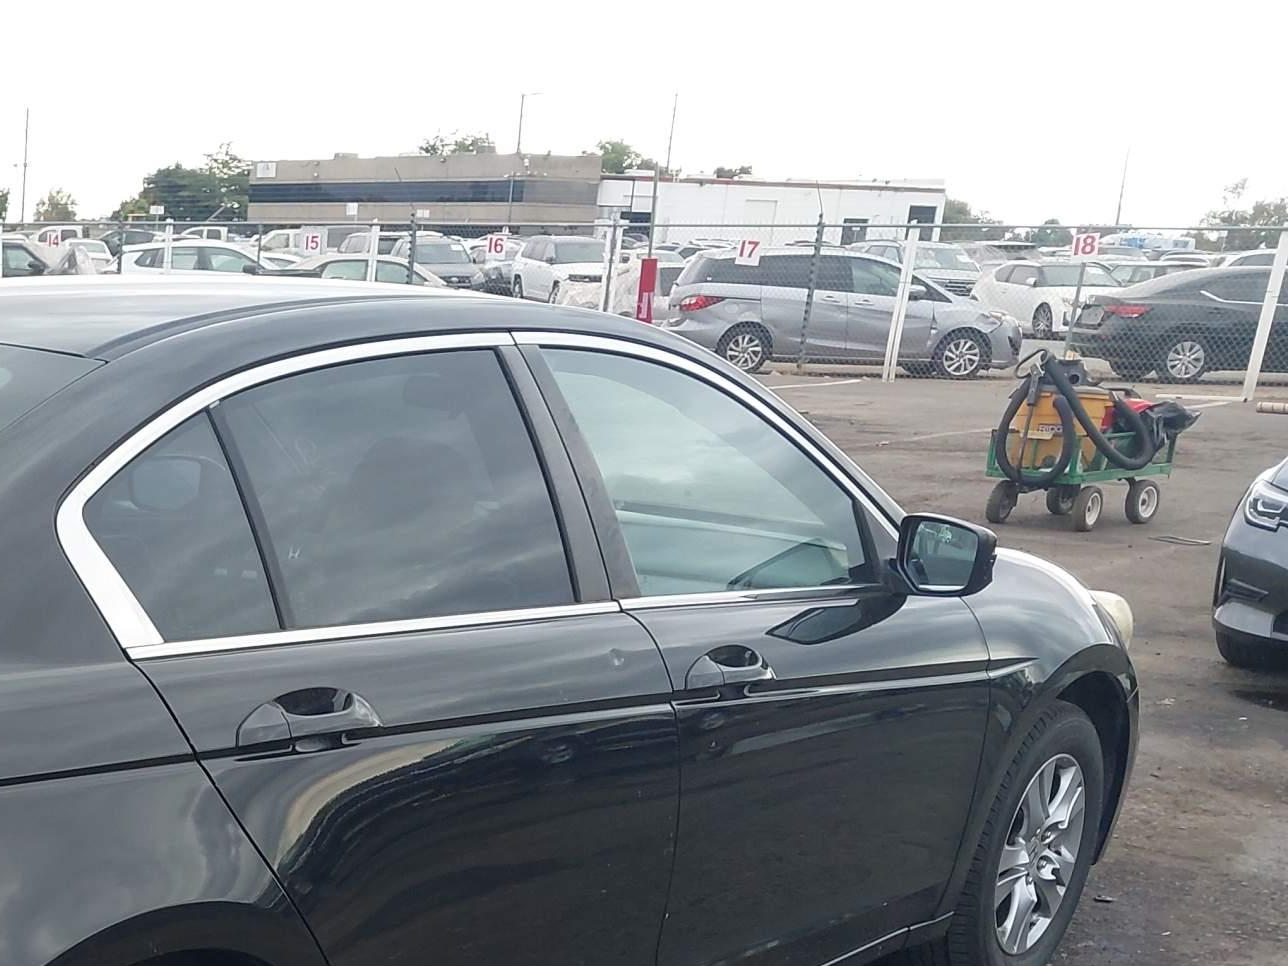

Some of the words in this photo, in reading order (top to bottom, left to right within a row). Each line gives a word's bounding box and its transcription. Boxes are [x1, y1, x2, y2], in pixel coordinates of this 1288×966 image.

[48, 233, 59, 248] 14
[305, 235, 319, 250] 15
[488, 237, 504, 254] 16
[739, 239, 760, 258] 17
[1073, 235, 1096, 256] 18
